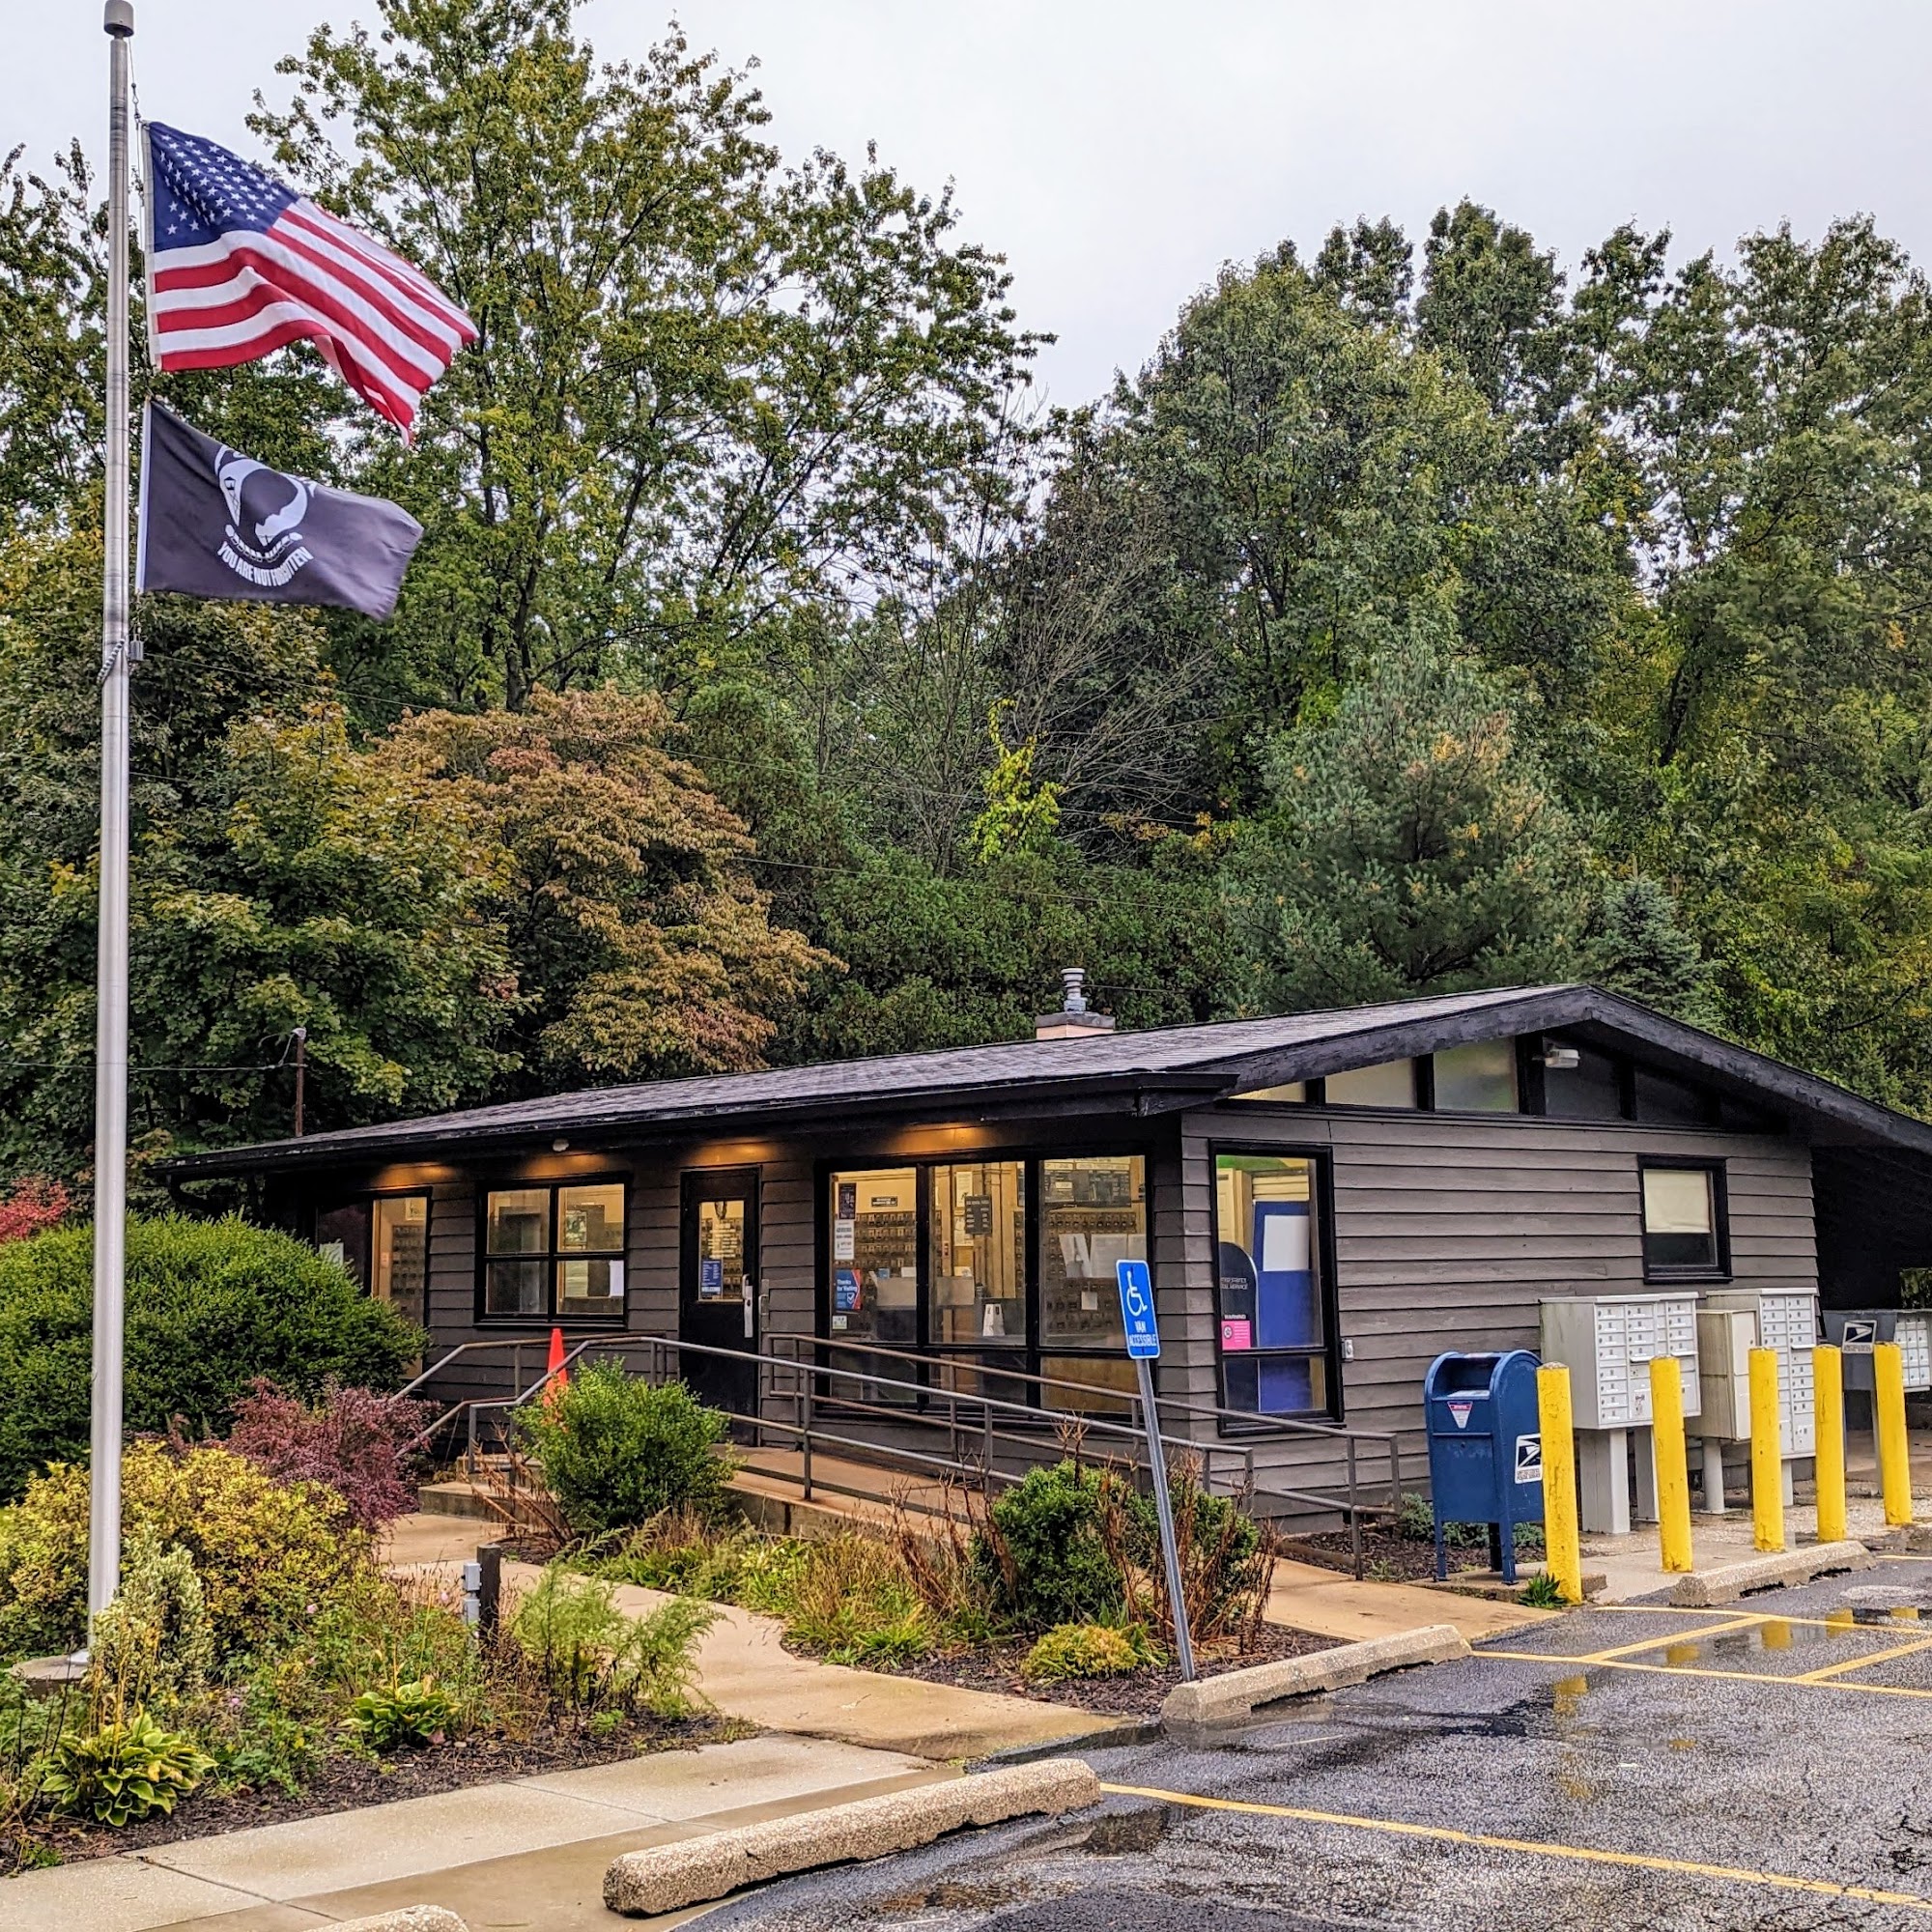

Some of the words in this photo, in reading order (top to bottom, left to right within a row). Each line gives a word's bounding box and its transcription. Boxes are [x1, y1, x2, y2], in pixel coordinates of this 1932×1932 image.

[217, 541, 239, 569] YOU
[235, 557, 254, 582] ARE
[253, 567, 271, 586] NOT
[270, 546, 314, 586] FORGOTTEN
[1135, 1321, 1147, 1333] VAN
[1128, 1334, 1157, 1347] ACCESSIBLE
